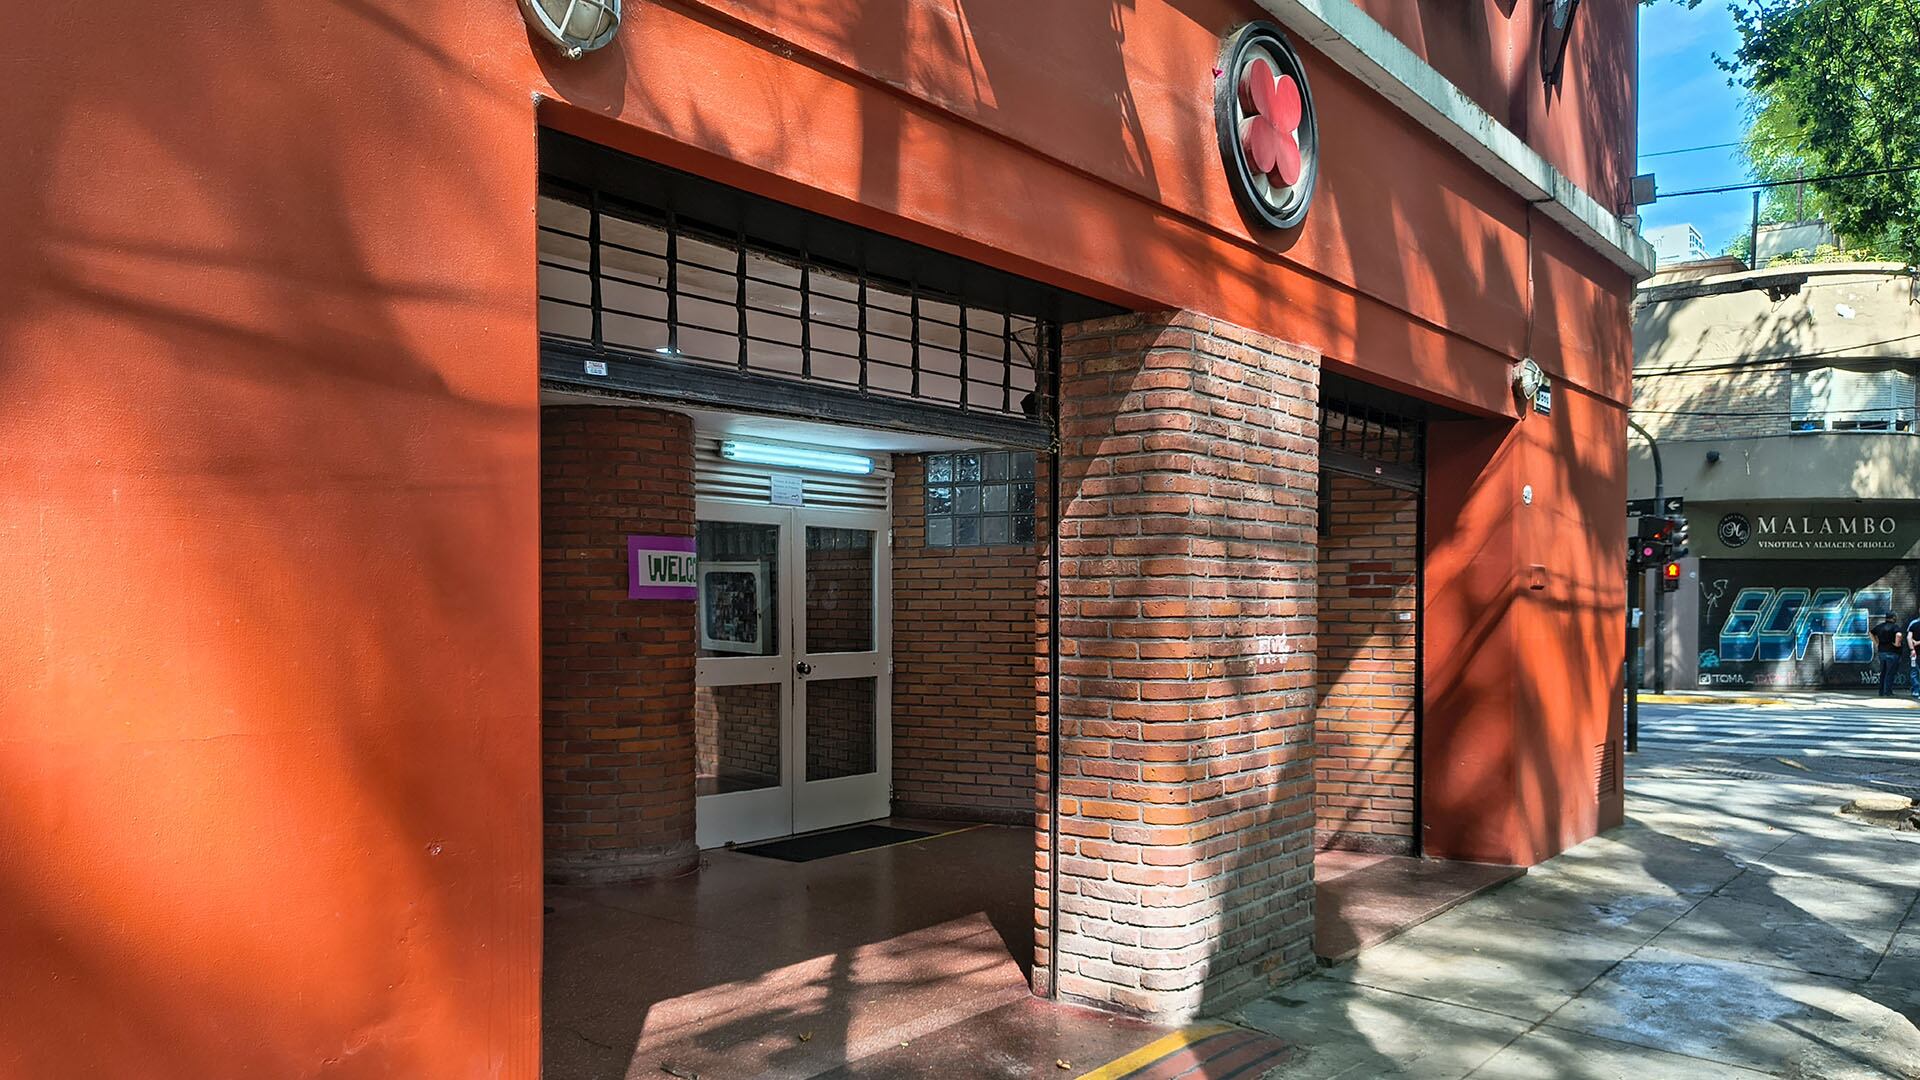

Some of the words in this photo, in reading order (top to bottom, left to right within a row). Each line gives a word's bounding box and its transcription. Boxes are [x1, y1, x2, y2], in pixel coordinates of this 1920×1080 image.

[1757, 517, 1896, 535] MALAMBO
[1758, 541, 1804, 549] VINOTECA
[1805, 541, 1812, 549] Y
[1814, 541, 1855, 549] ALMACEN
[1857, 541, 1895, 549] CRIOLLO
